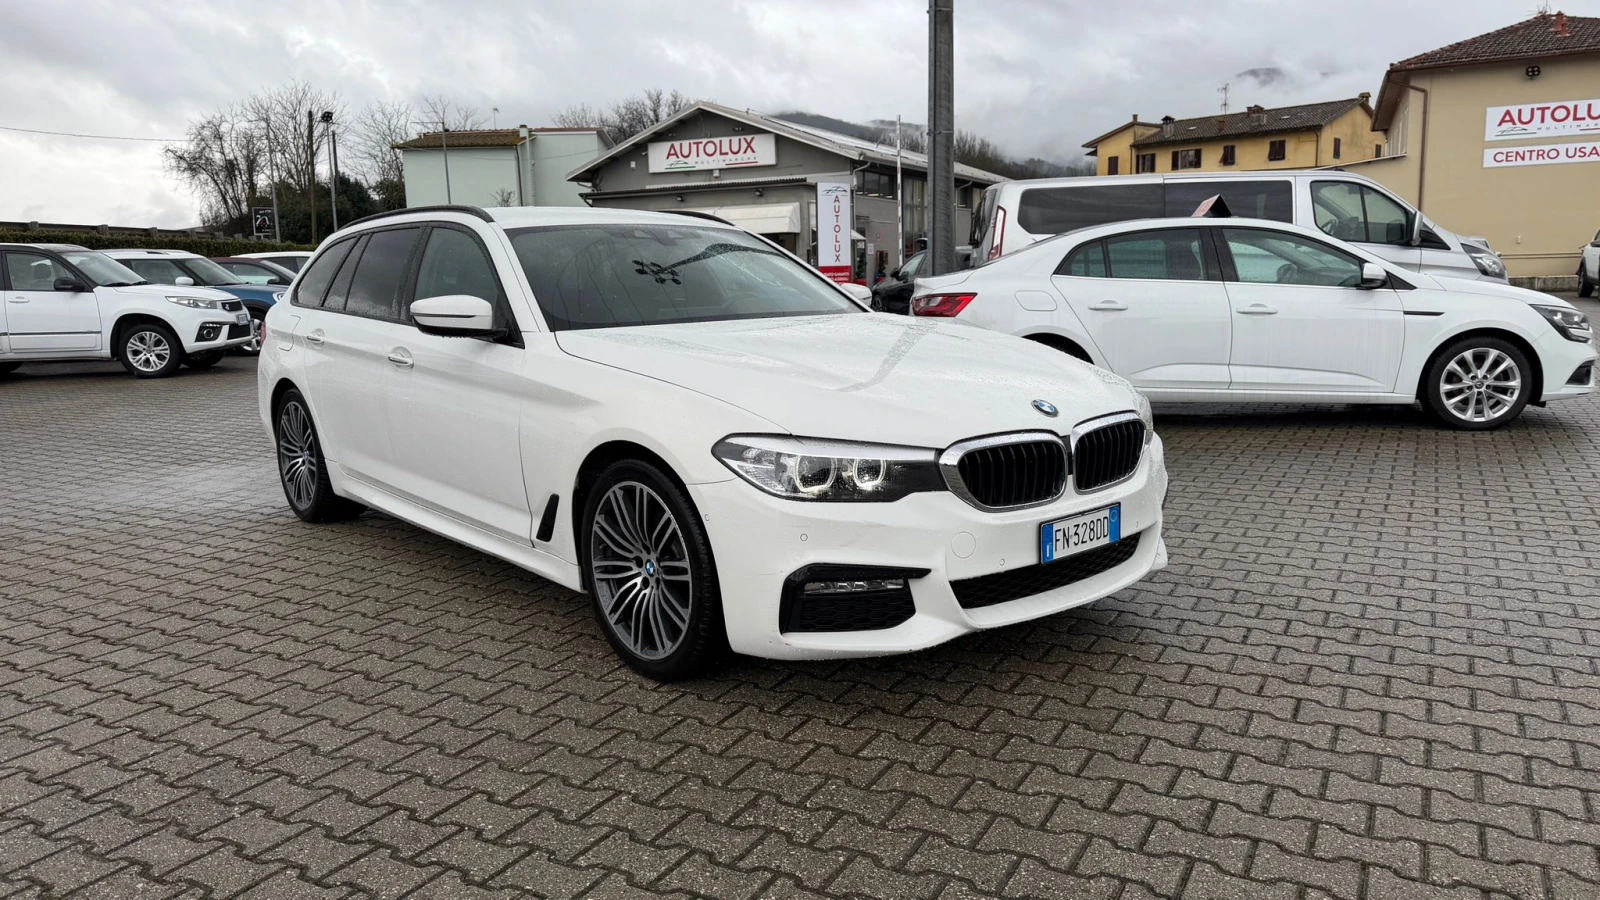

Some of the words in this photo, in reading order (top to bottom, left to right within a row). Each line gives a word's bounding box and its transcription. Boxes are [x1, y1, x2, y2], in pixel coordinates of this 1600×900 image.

[666, 136, 756, 160] AUTOLUX
[1493, 148, 1560, 163] CENTRO
[1565, 146, 1600, 158] USA
[695, 156, 757, 164] MULTIMARCHE
[833, 195, 841, 262] AUTOLUX
